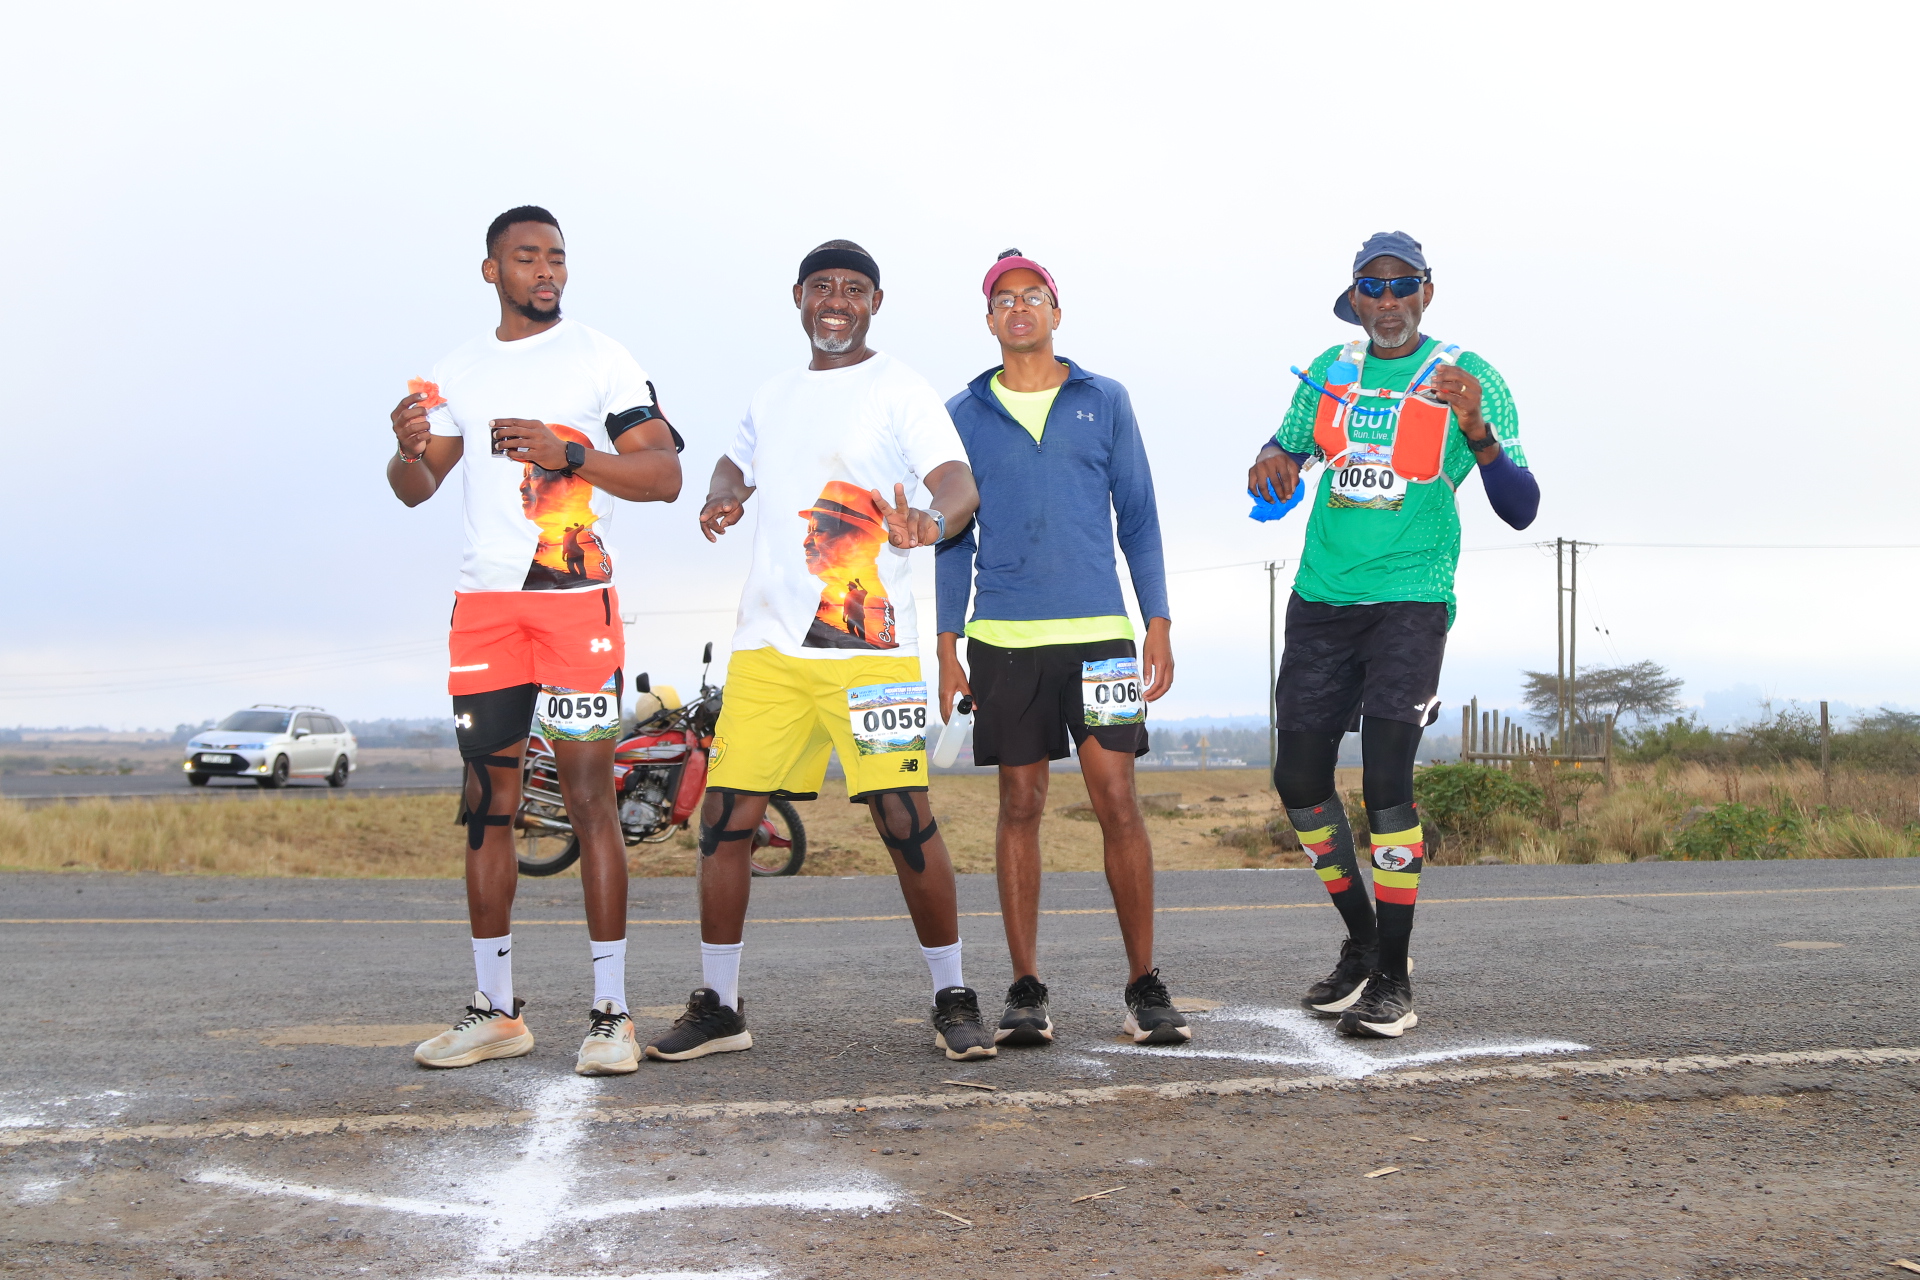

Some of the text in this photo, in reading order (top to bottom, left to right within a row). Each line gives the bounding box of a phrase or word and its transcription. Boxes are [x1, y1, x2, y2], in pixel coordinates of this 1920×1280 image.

[1353, 429, 1370, 439] Run.
[1371, 430, 1389, 441] Live.
[1339, 467, 1394, 490] 0080
[547, 696, 608, 719] 0059
[863, 706, 926, 733] 0058
